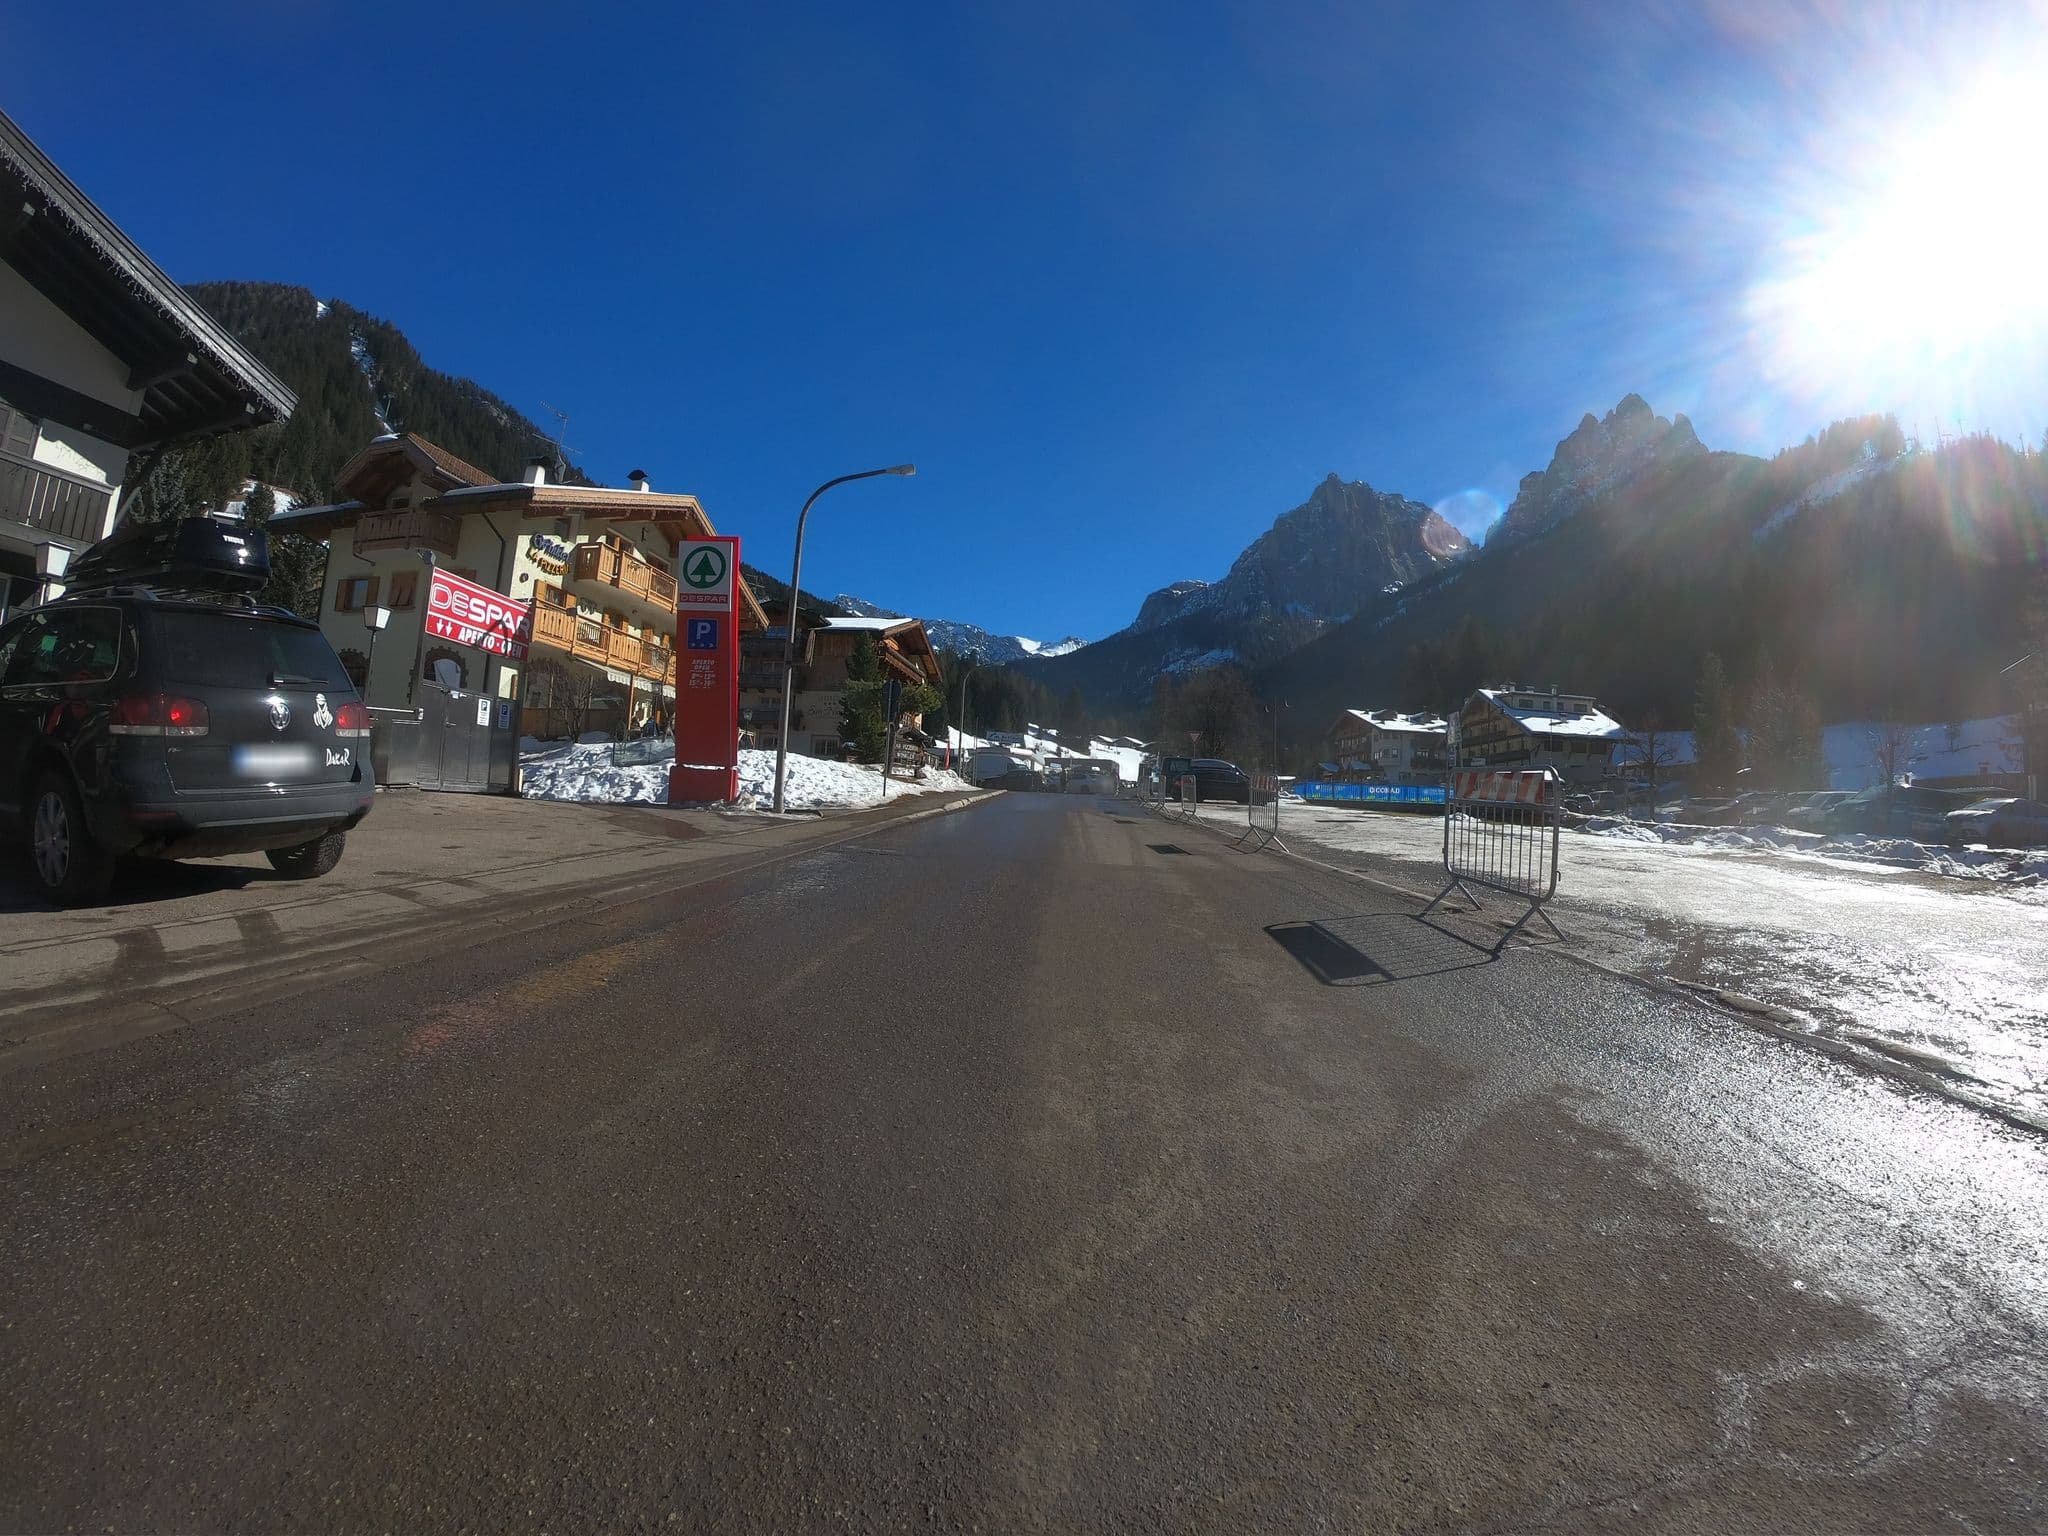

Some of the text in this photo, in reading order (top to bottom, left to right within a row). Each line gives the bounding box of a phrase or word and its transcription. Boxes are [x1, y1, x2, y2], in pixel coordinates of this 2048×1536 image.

[680, 594, 727, 603] DESPAR
[430, 582, 530, 639] DESPAR
[458, 626, 495, 650] APERTO
[696, 622, 711, 639] P
